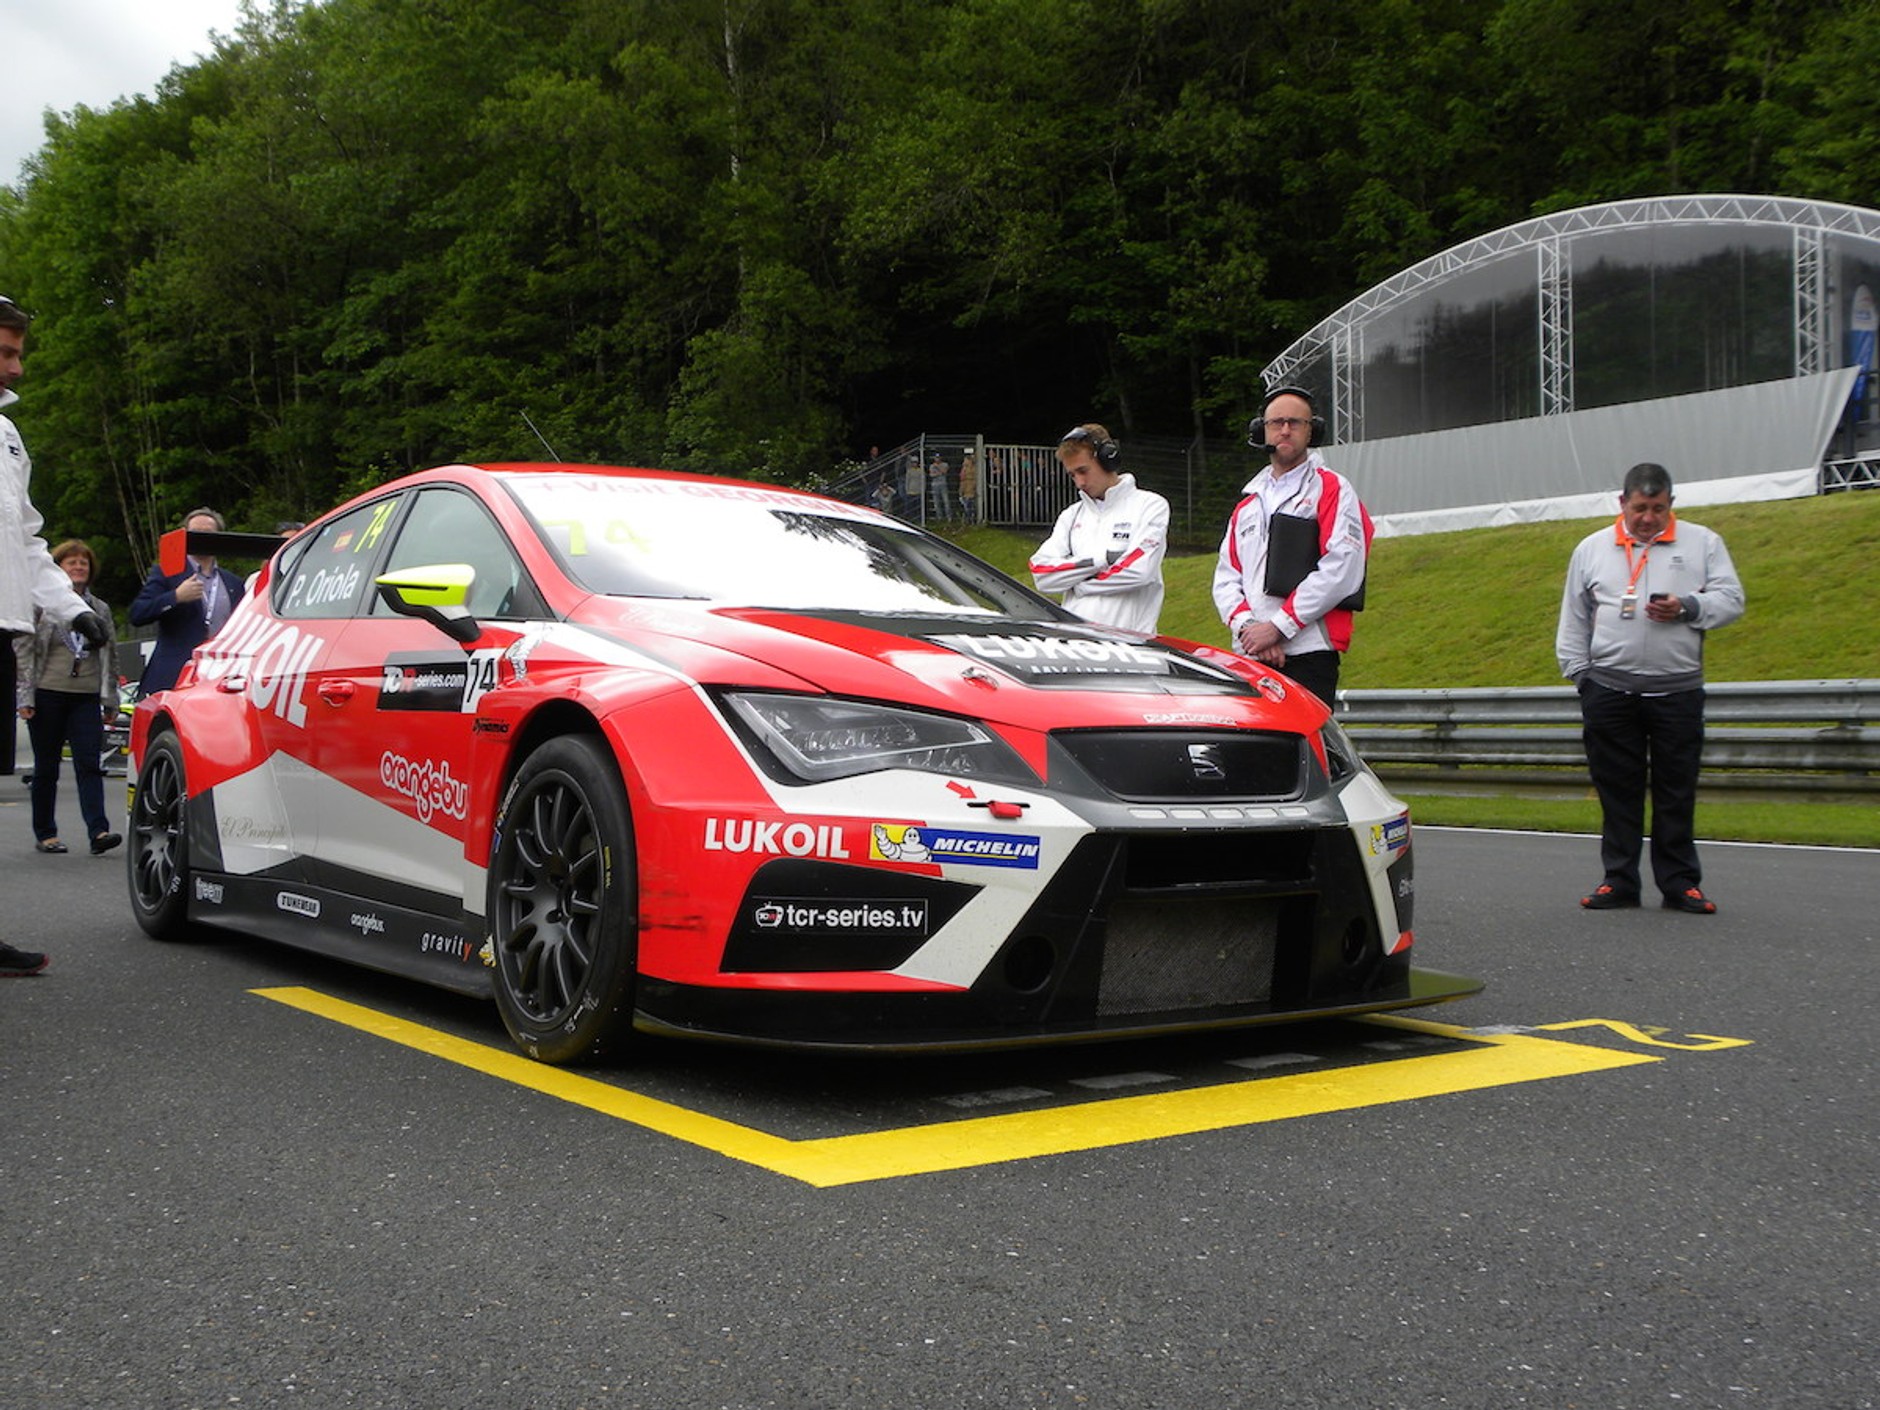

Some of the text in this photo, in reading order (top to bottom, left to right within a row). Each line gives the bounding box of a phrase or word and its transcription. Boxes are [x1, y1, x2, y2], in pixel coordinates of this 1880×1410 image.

[574, 480, 862, 518] Visit GEORGIA
[354, 501, 397, 553] 74
[540, 519, 654, 556] 74
[285, 563, 360, 609] P. Oriola
[196, 605, 325, 729] LUKOIL
[957, 634, 1164, 665] LUKOIL
[466, 658, 496, 703] 74
[704, 817, 850, 859] LUKOIL
[932, 838, 1040, 857] MICHELIN
[787, 904, 924, 927] tcr-series.tv
[421, 932, 473, 962] gravity
